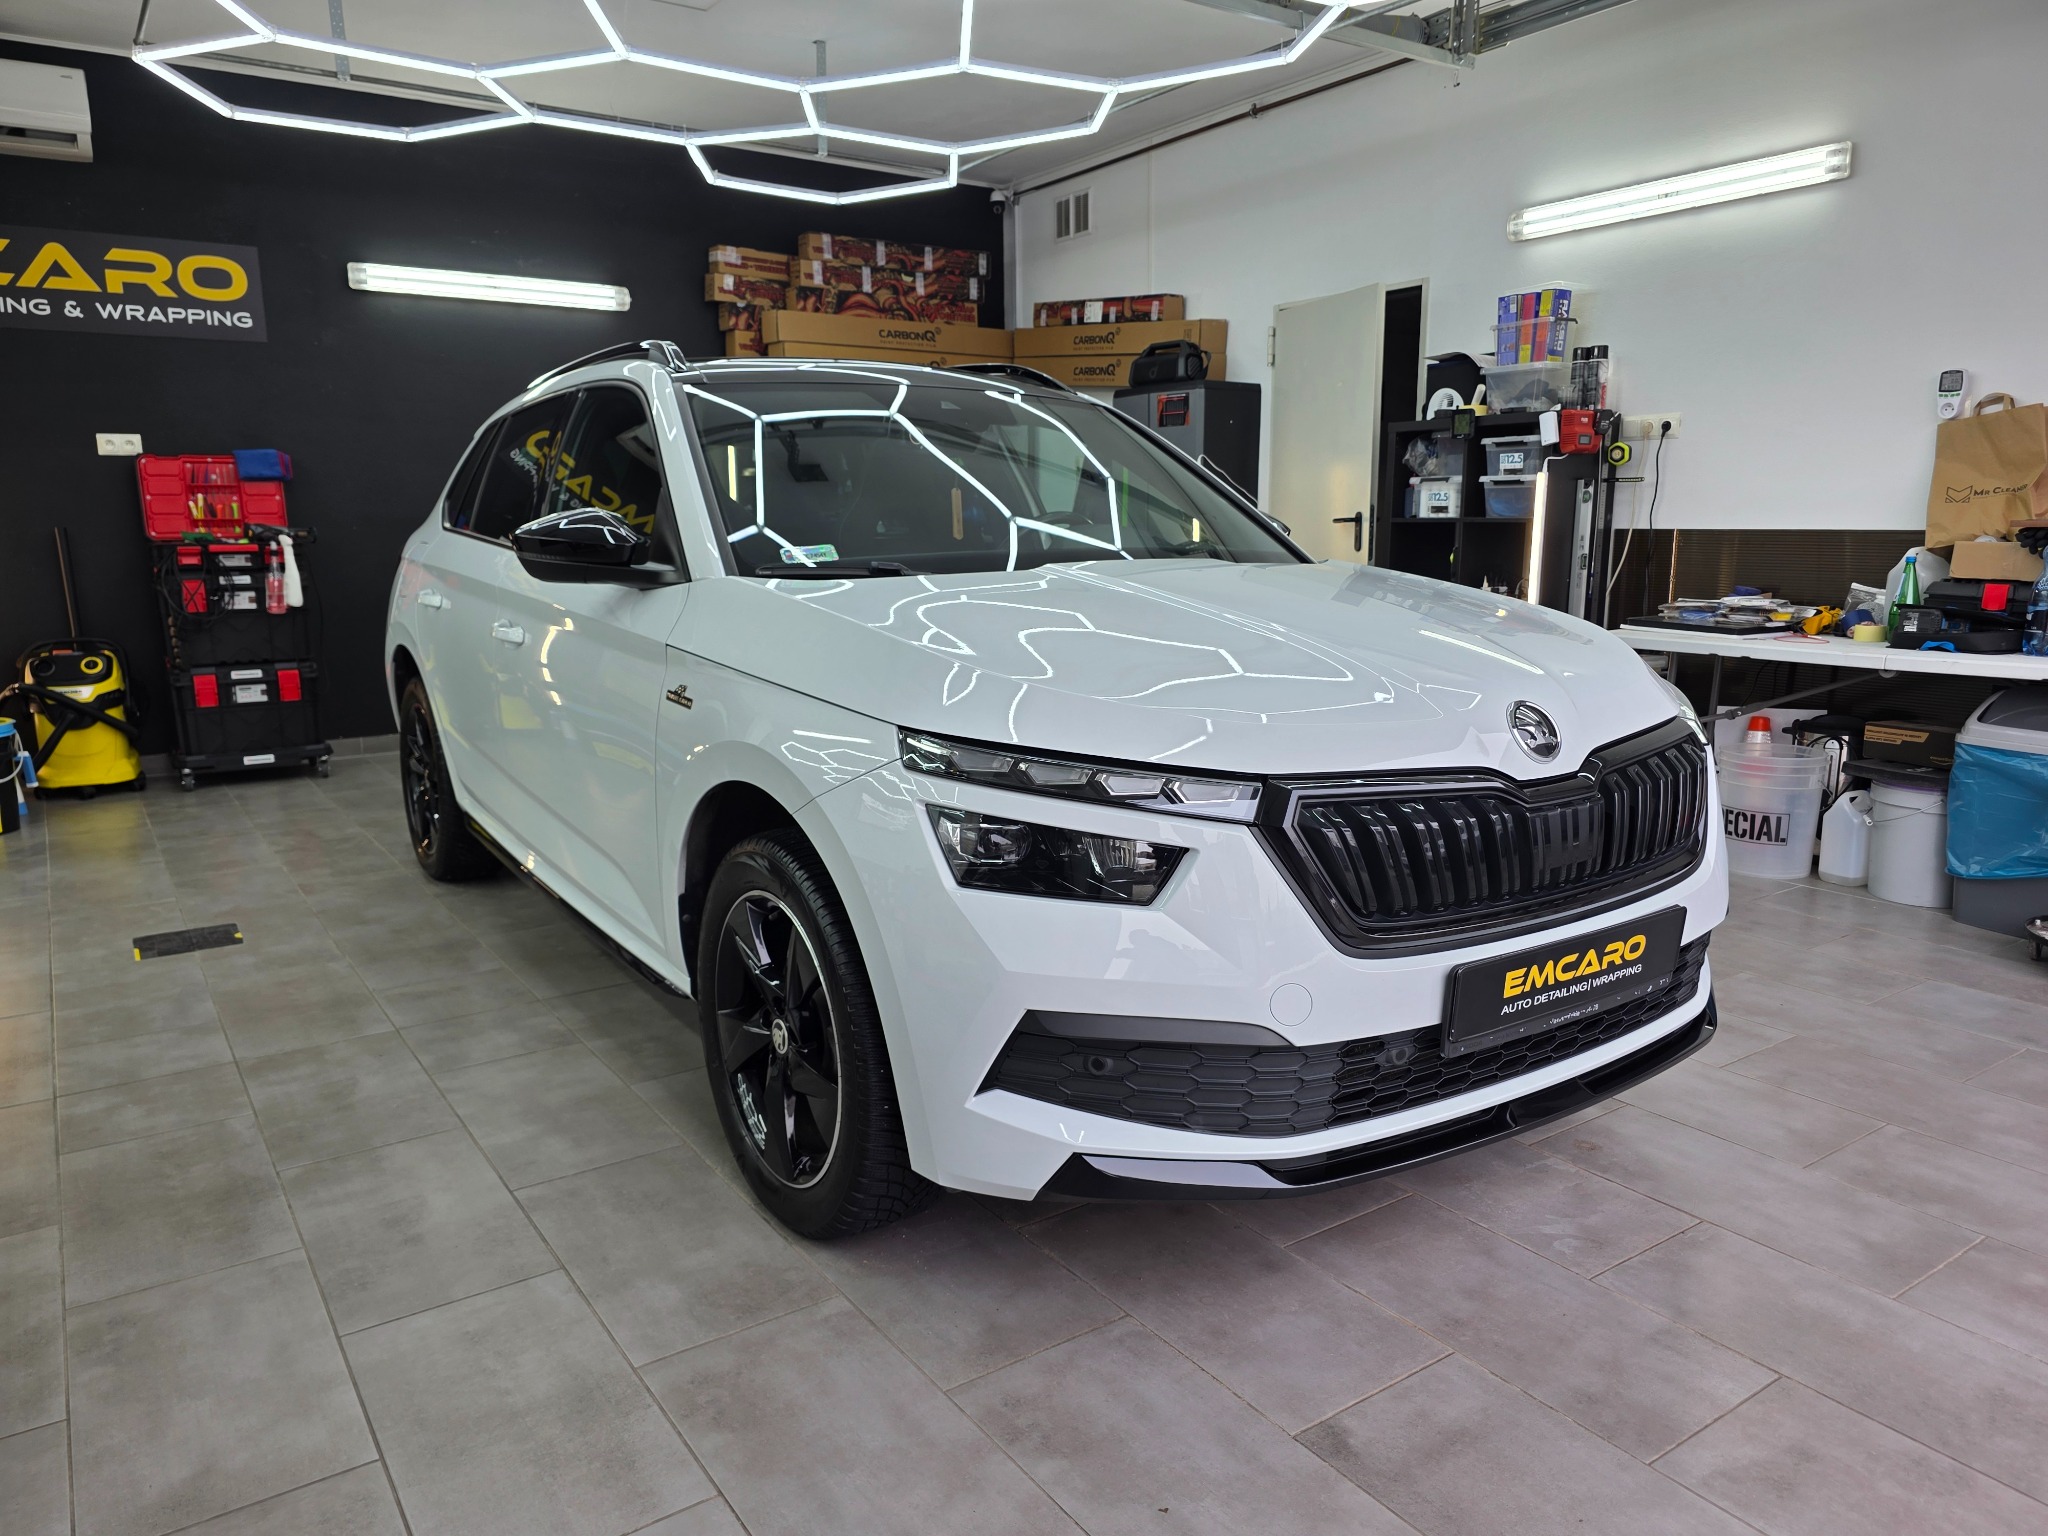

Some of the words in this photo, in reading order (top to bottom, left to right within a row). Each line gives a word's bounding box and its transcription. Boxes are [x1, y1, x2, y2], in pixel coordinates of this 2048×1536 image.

[0, 239, 248, 302] ARO
[64, 300, 84, 319] &
[95, 302, 253, 328] WRAPPING
[1721, 807, 1786, 843] ECIAL
[1500, 998, 1531, 1016] AUTO
[1592, 964, 1643, 988] WRAPPING
[1503, 934, 1647, 998] EMCARO
